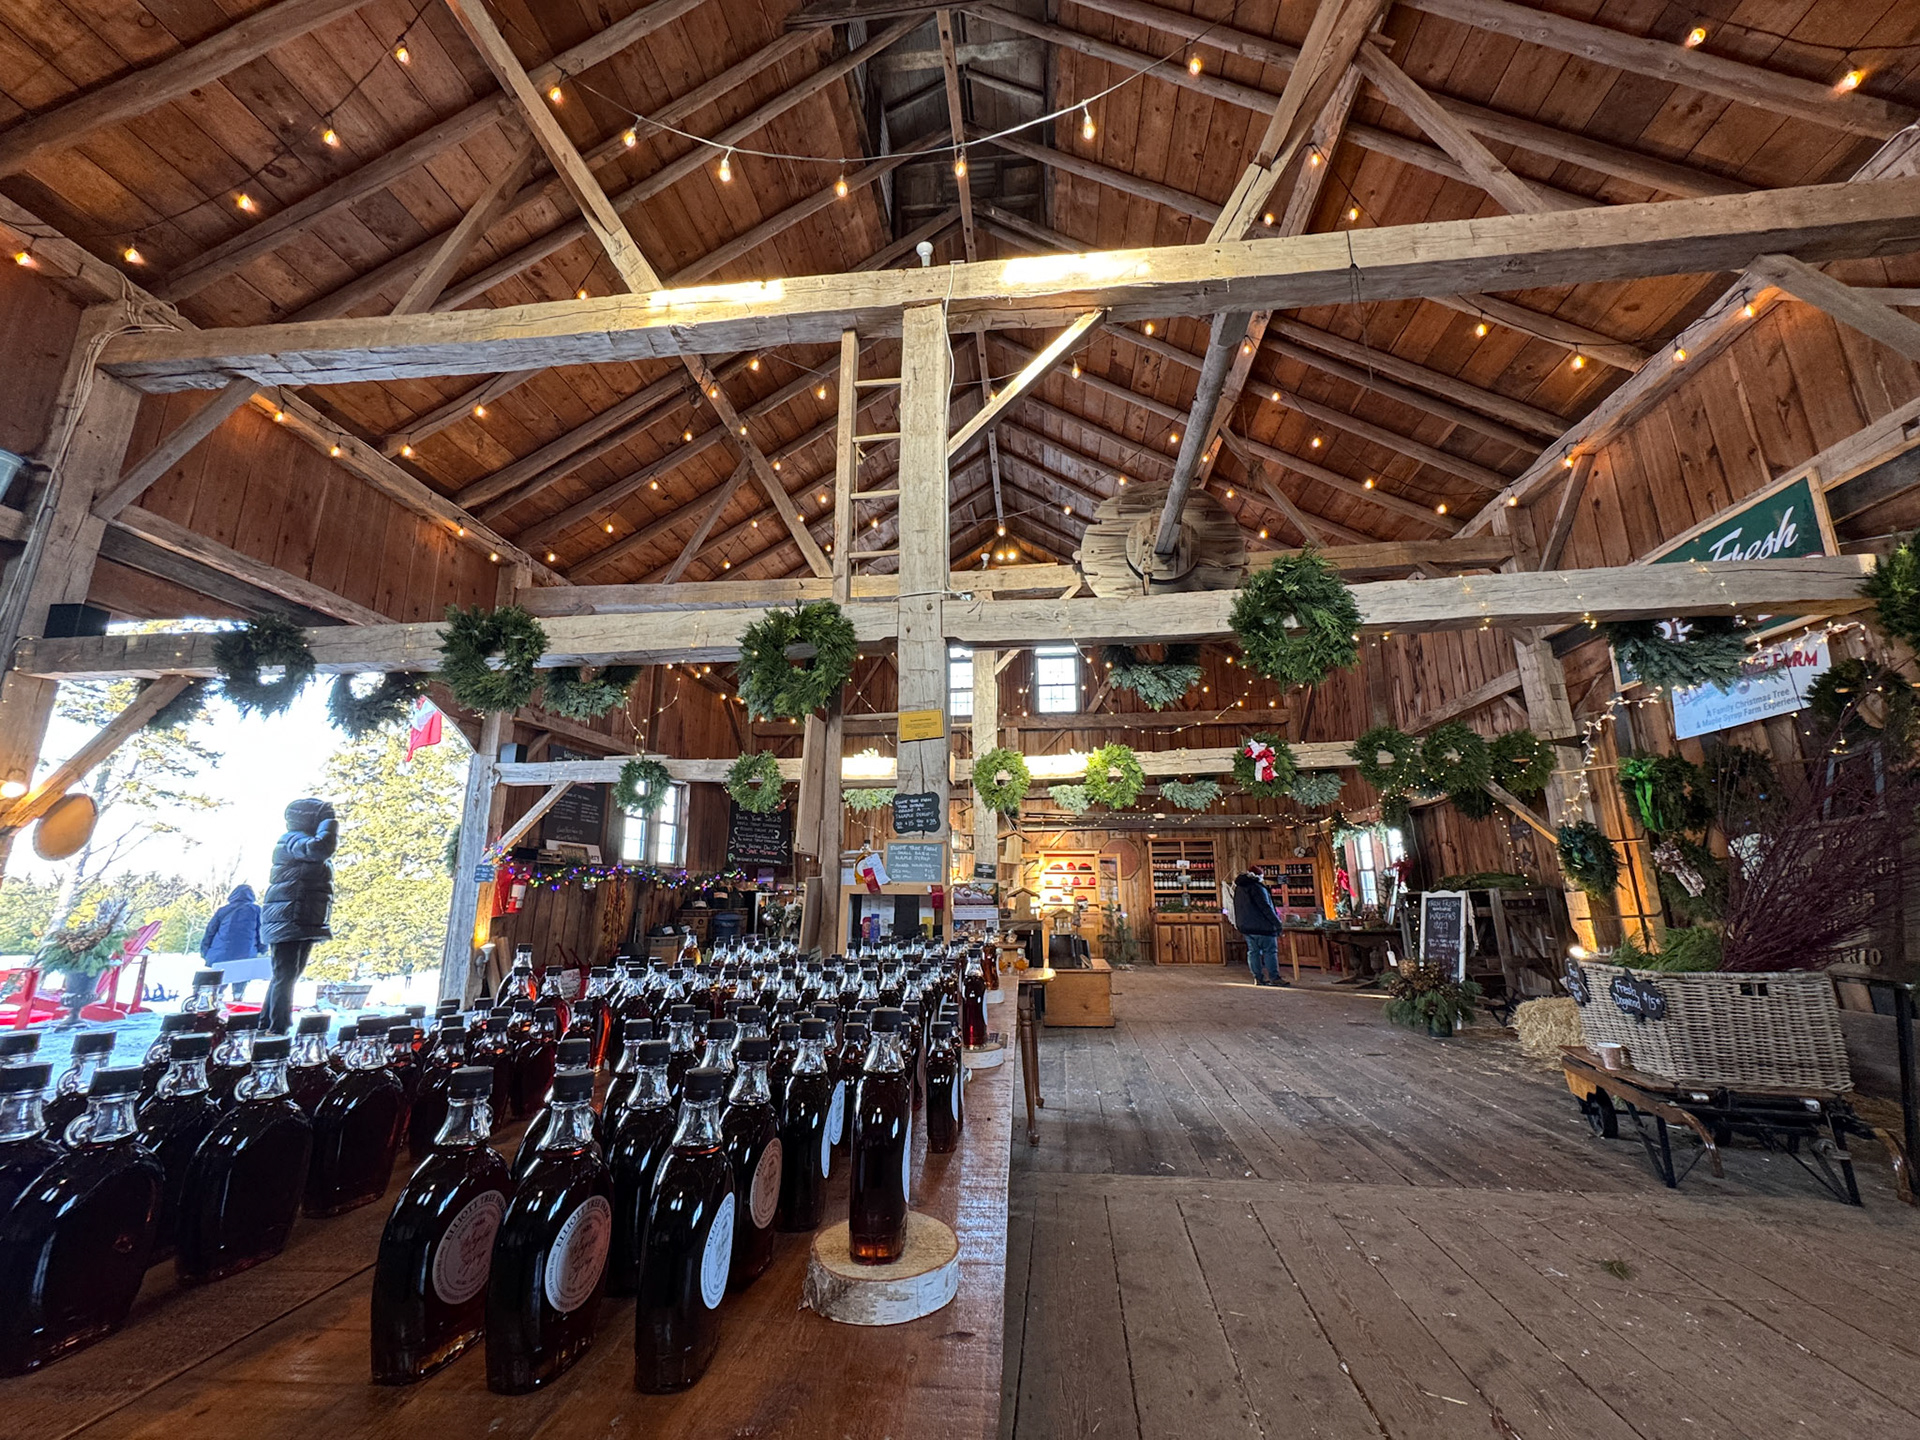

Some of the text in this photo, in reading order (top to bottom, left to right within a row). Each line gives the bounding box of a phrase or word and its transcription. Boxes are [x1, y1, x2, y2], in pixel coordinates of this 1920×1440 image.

[1708, 505, 1799, 561] Fresh
[1773, 650, 1818, 668] FARM
[1702, 715, 1722, 728] Maple
[1723, 711, 1743, 723] Syrup
[1743, 706, 1762, 717] Farm
[1763, 696, 1802, 712] Experien
[1712, 703, 1734, 717] Family
[1735, 694, 1772, 709] Christmas
[1772, 688, 1790, 700] Tree
[445, 1200, 478, 1240] ELLIOTT
[556, 1205, 585, 1247] ELLIOTT
